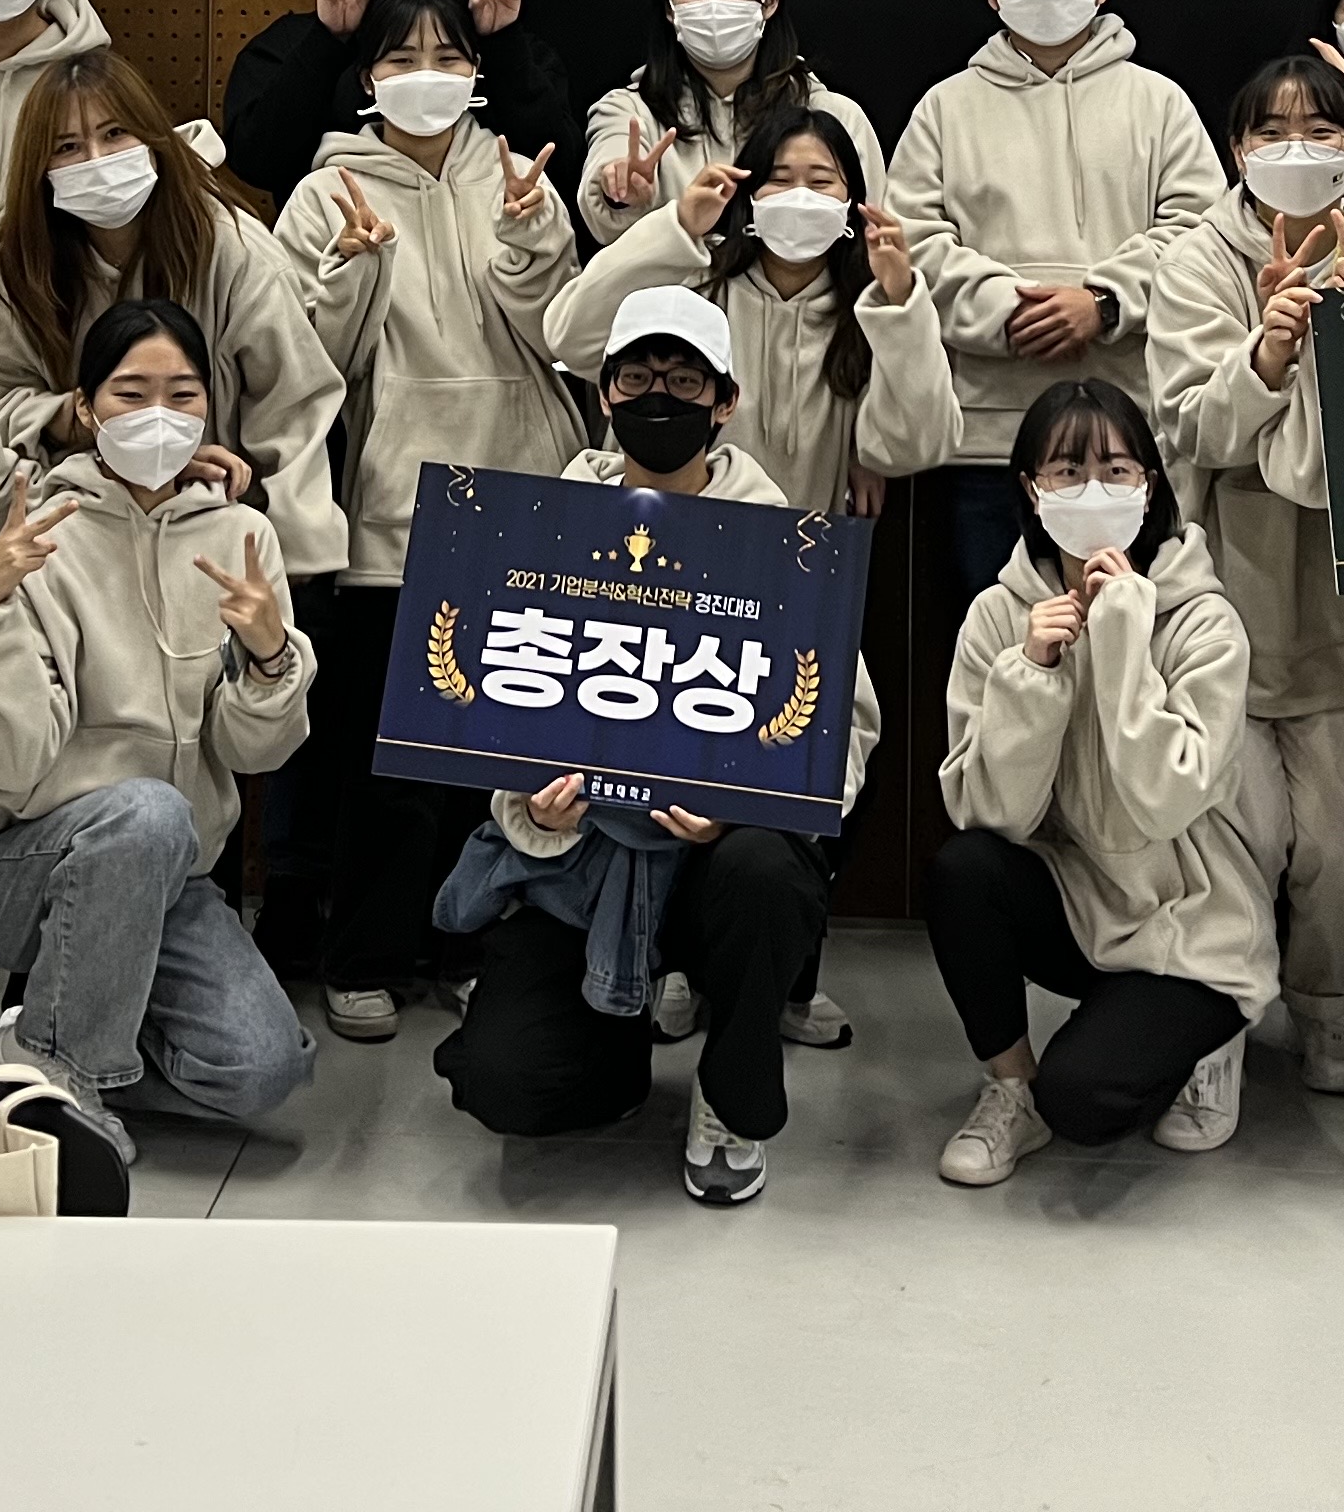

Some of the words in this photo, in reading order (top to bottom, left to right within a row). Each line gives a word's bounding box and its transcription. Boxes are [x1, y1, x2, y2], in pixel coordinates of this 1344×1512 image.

[506, 569, 545, 590] 2021
[550, 573, 692, 610] 기업분석&혁신전략
[694, 592, 761, 620] 경진대회
[479, 607, 772, 735] 총장상
